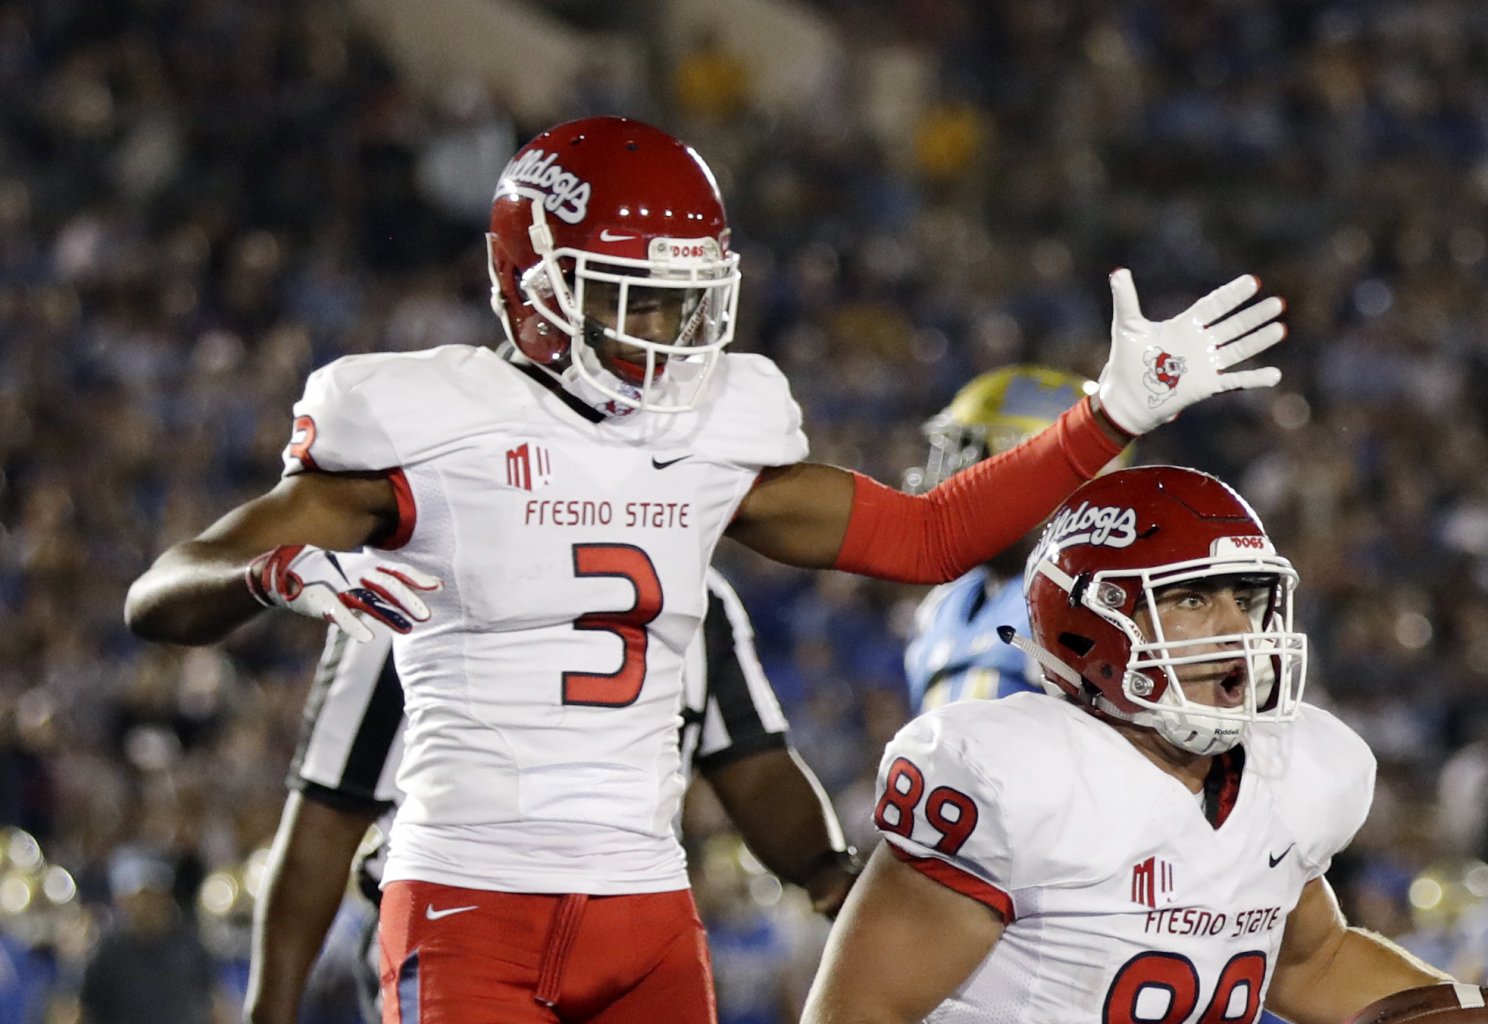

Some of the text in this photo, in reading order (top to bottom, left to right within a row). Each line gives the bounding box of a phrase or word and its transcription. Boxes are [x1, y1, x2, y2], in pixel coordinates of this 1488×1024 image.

[524, 500, 690, 528] FRESNO STATE
[562, 543, 664, 708] 3
[873, 756, 979, 855] 89
[1144, 906, 1281, 938] FRESNO STATE
